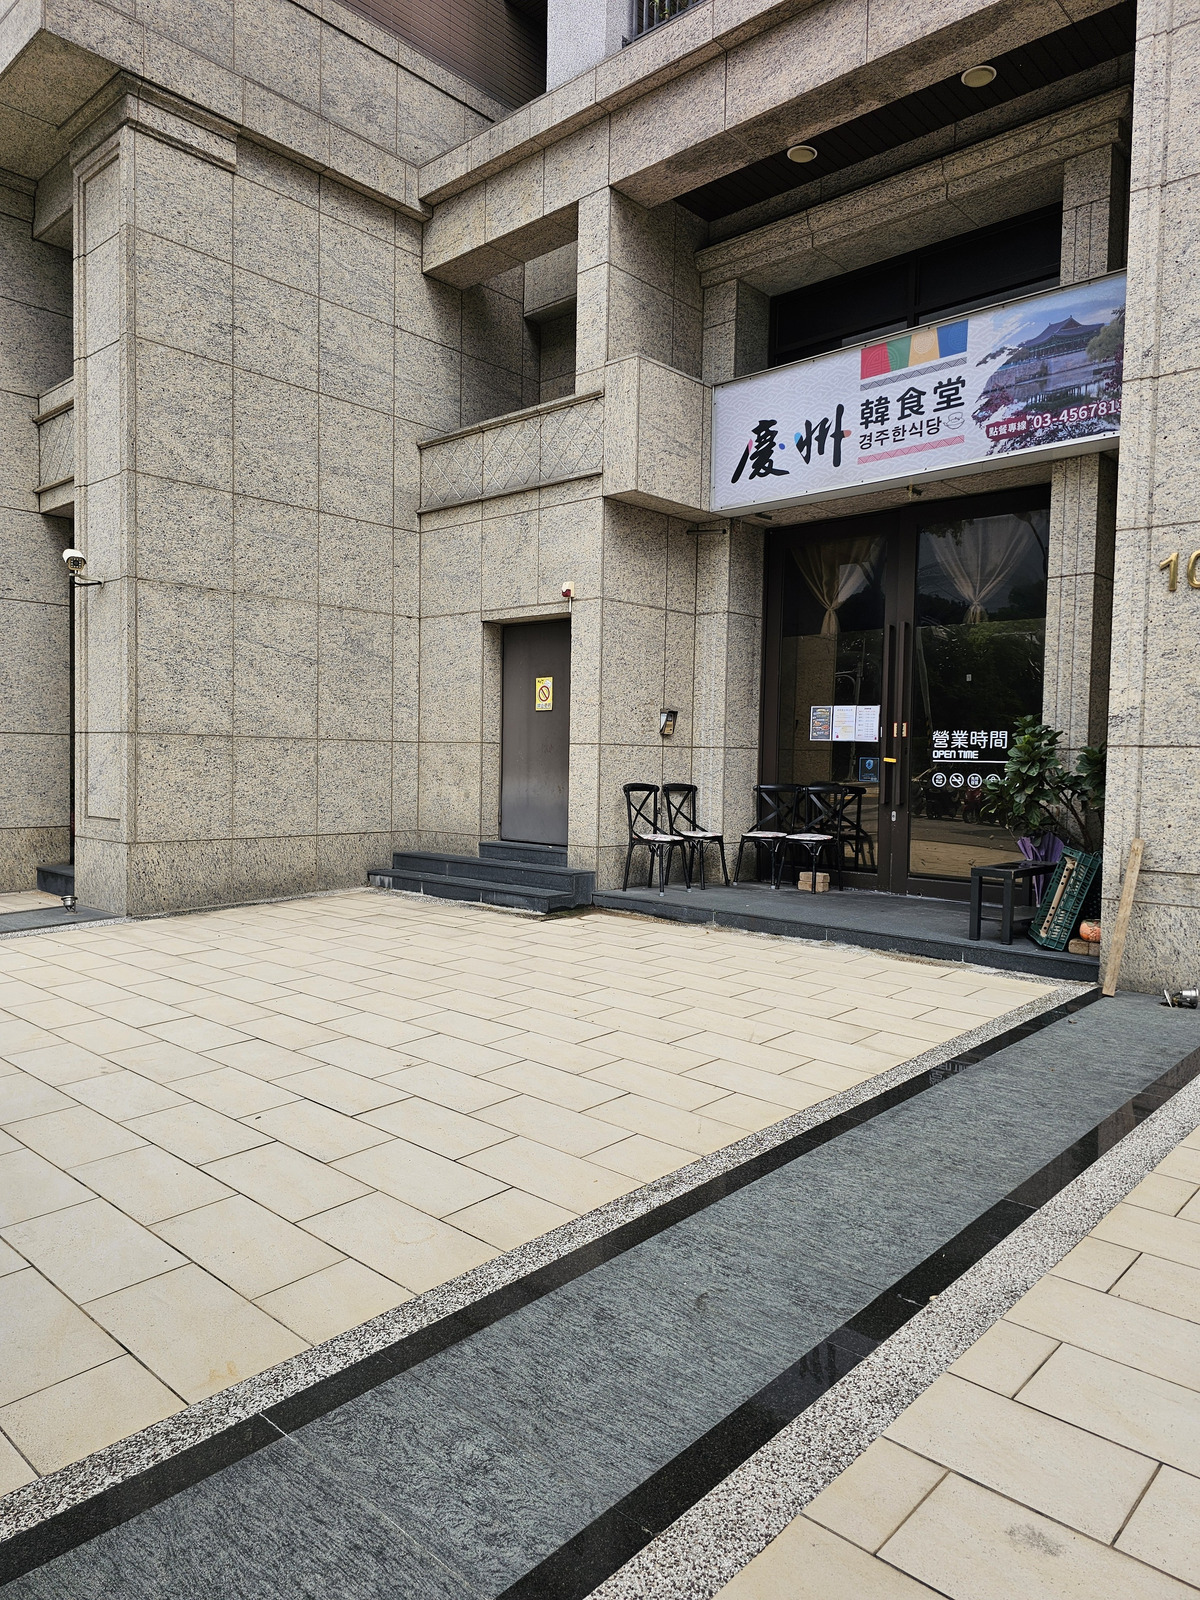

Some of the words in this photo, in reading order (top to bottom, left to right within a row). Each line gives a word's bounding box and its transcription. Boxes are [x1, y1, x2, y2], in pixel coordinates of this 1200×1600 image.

[859, 375, 966, 430] 韓食堂
[858, 416, 942, 450] 경주한식당
[988, 420, 1027, 438] 點餐專線
[731, 404, 852, 484] 慶州
[932, 730, 1008, 749] 營業時間
[932, 750, 957, 759] OPEN
[957, 750, 979, 759] TIME
